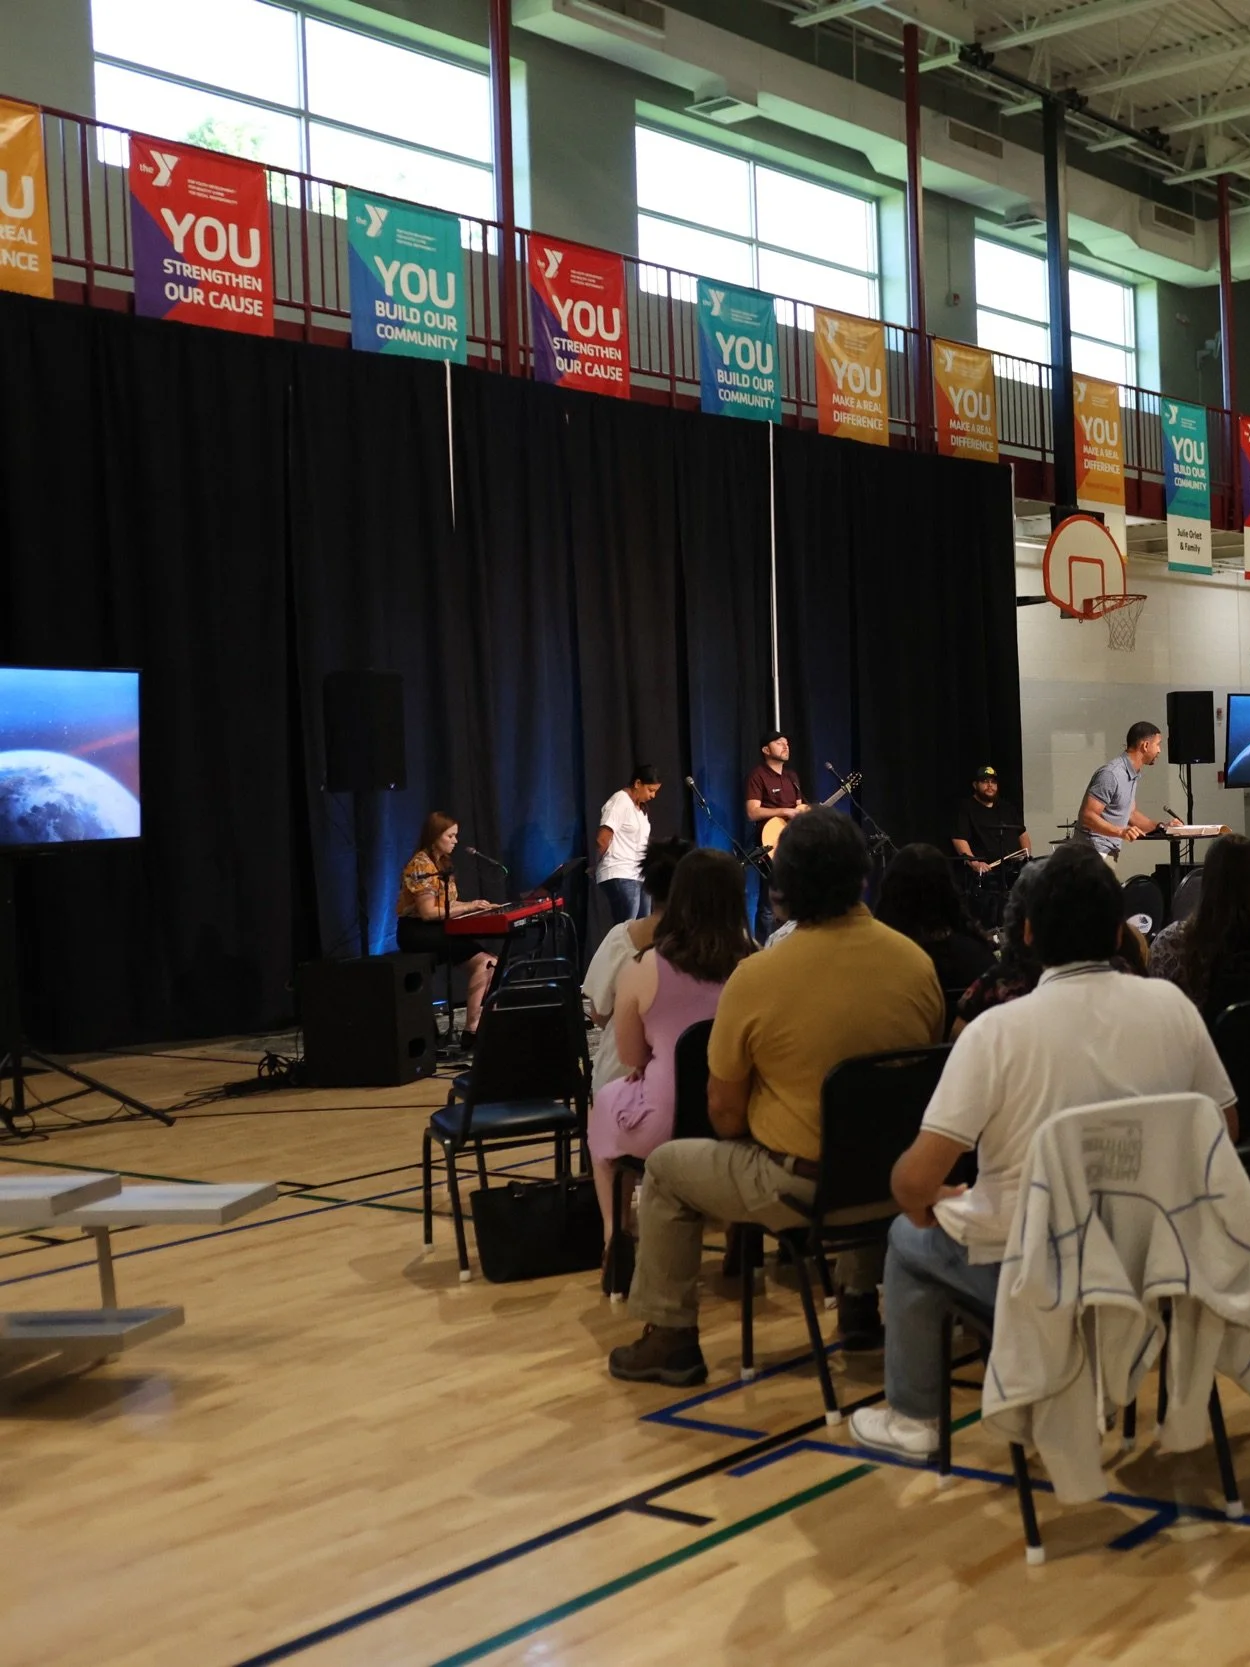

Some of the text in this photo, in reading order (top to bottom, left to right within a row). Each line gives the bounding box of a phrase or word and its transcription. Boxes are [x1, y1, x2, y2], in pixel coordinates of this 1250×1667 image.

[139, 150, 179, 187] the Y
[364, 203, 389, 237] Y
[160, 207, 261, 268] YOU
[162, 258, 262, 292] STRENGTHEN
[373, 255, 455, 309] YOU
[164, 282, 263, 317] OUR CAUSE
[375, 299, 458, 332] BUILD OUR
[551, 294, 621, 341] YOU
[376, 323, 458, 352] COMMUNITY
[553, 337, 621, 360] STRENGTHEN
[715, 331, 773, 374] YOU
[555, 356, 623, 382] OUR CAUSE
[717, 368, 775, 393] BUILD OUR
[831, 357, 882, 397] YOU
[718, 388, 775, 410] COMMUNITY
[832, 393, 883, 414] MAKE A REAL
[948, 385, 990, 421] YOU
[833, 411, 883, 430] DIFFERENCE
[950, 419, 992, 436] MAKE A REAL
[1081, 414, 1118, 446] YOU
[951, 435, 994, 452] DIFFERENCE
[1171, 435, 1205, 465] YOU
[1084, 458, 1121, 474] DIFFERENCE
[1173, 463, 1206, 479] BUILD OUR
[1174, 477, 1207, 491] COMMUNITY
[1177, 528, 1189, 538] Julie
[1180, 542, 1200, 555] & Family
